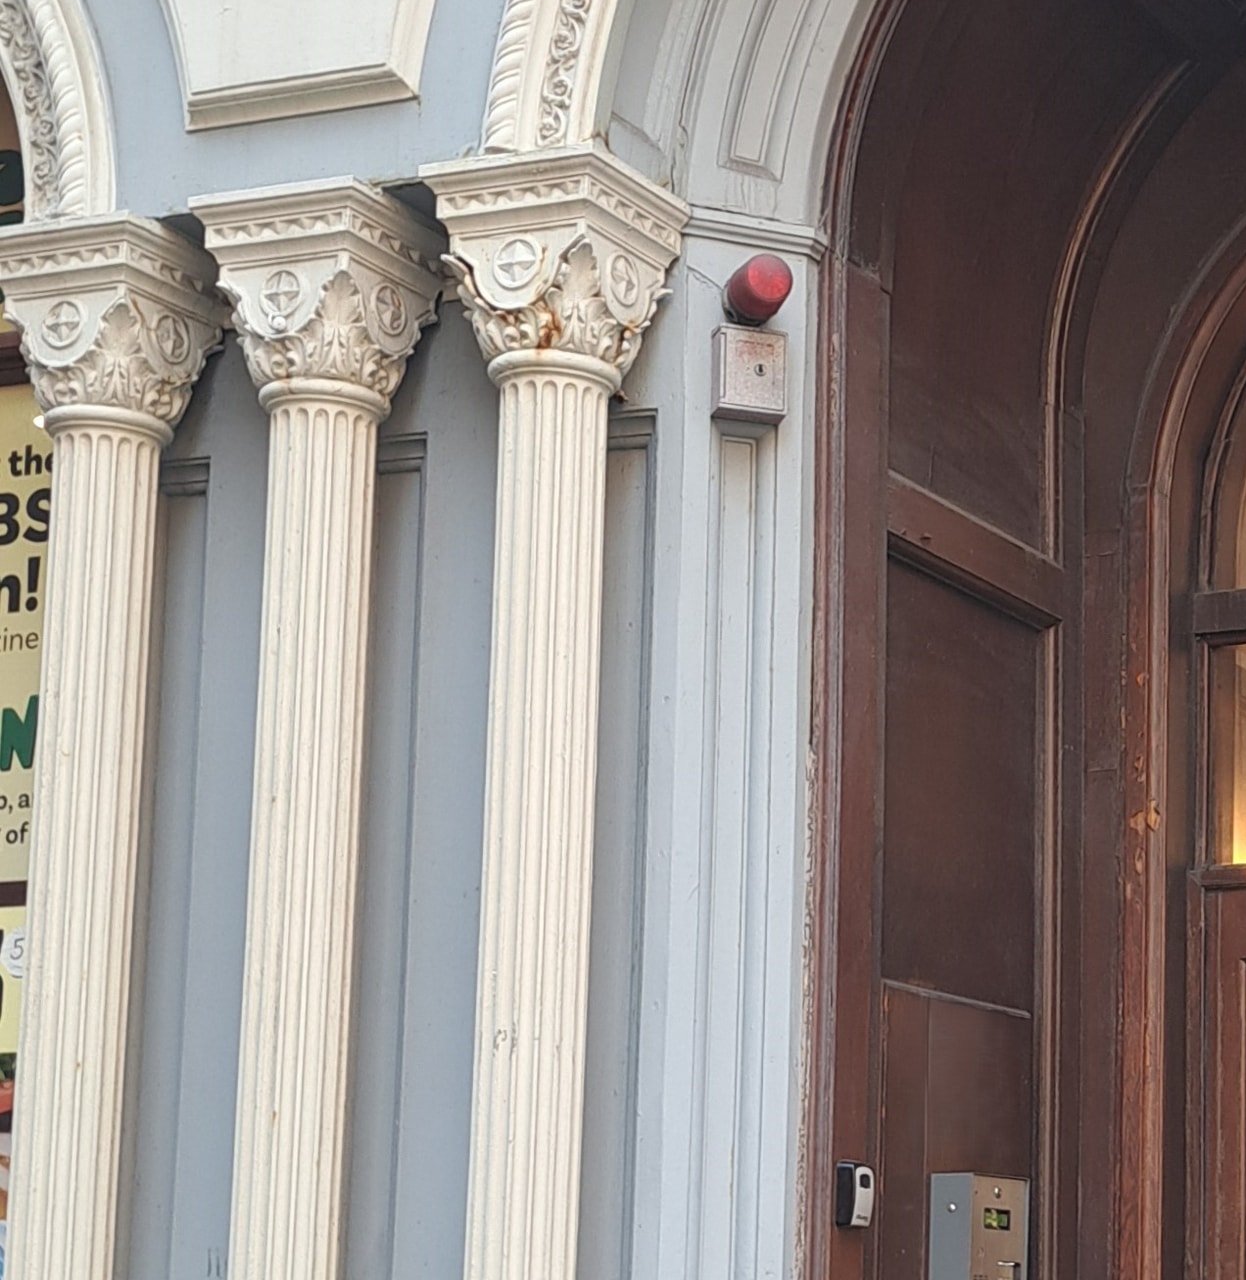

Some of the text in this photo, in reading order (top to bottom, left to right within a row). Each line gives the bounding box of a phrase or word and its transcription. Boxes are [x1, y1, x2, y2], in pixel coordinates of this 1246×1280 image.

[0, 626, 39, 652] ine
[18, 793, 34, 808] a
[5, 821, 30, 844] of
